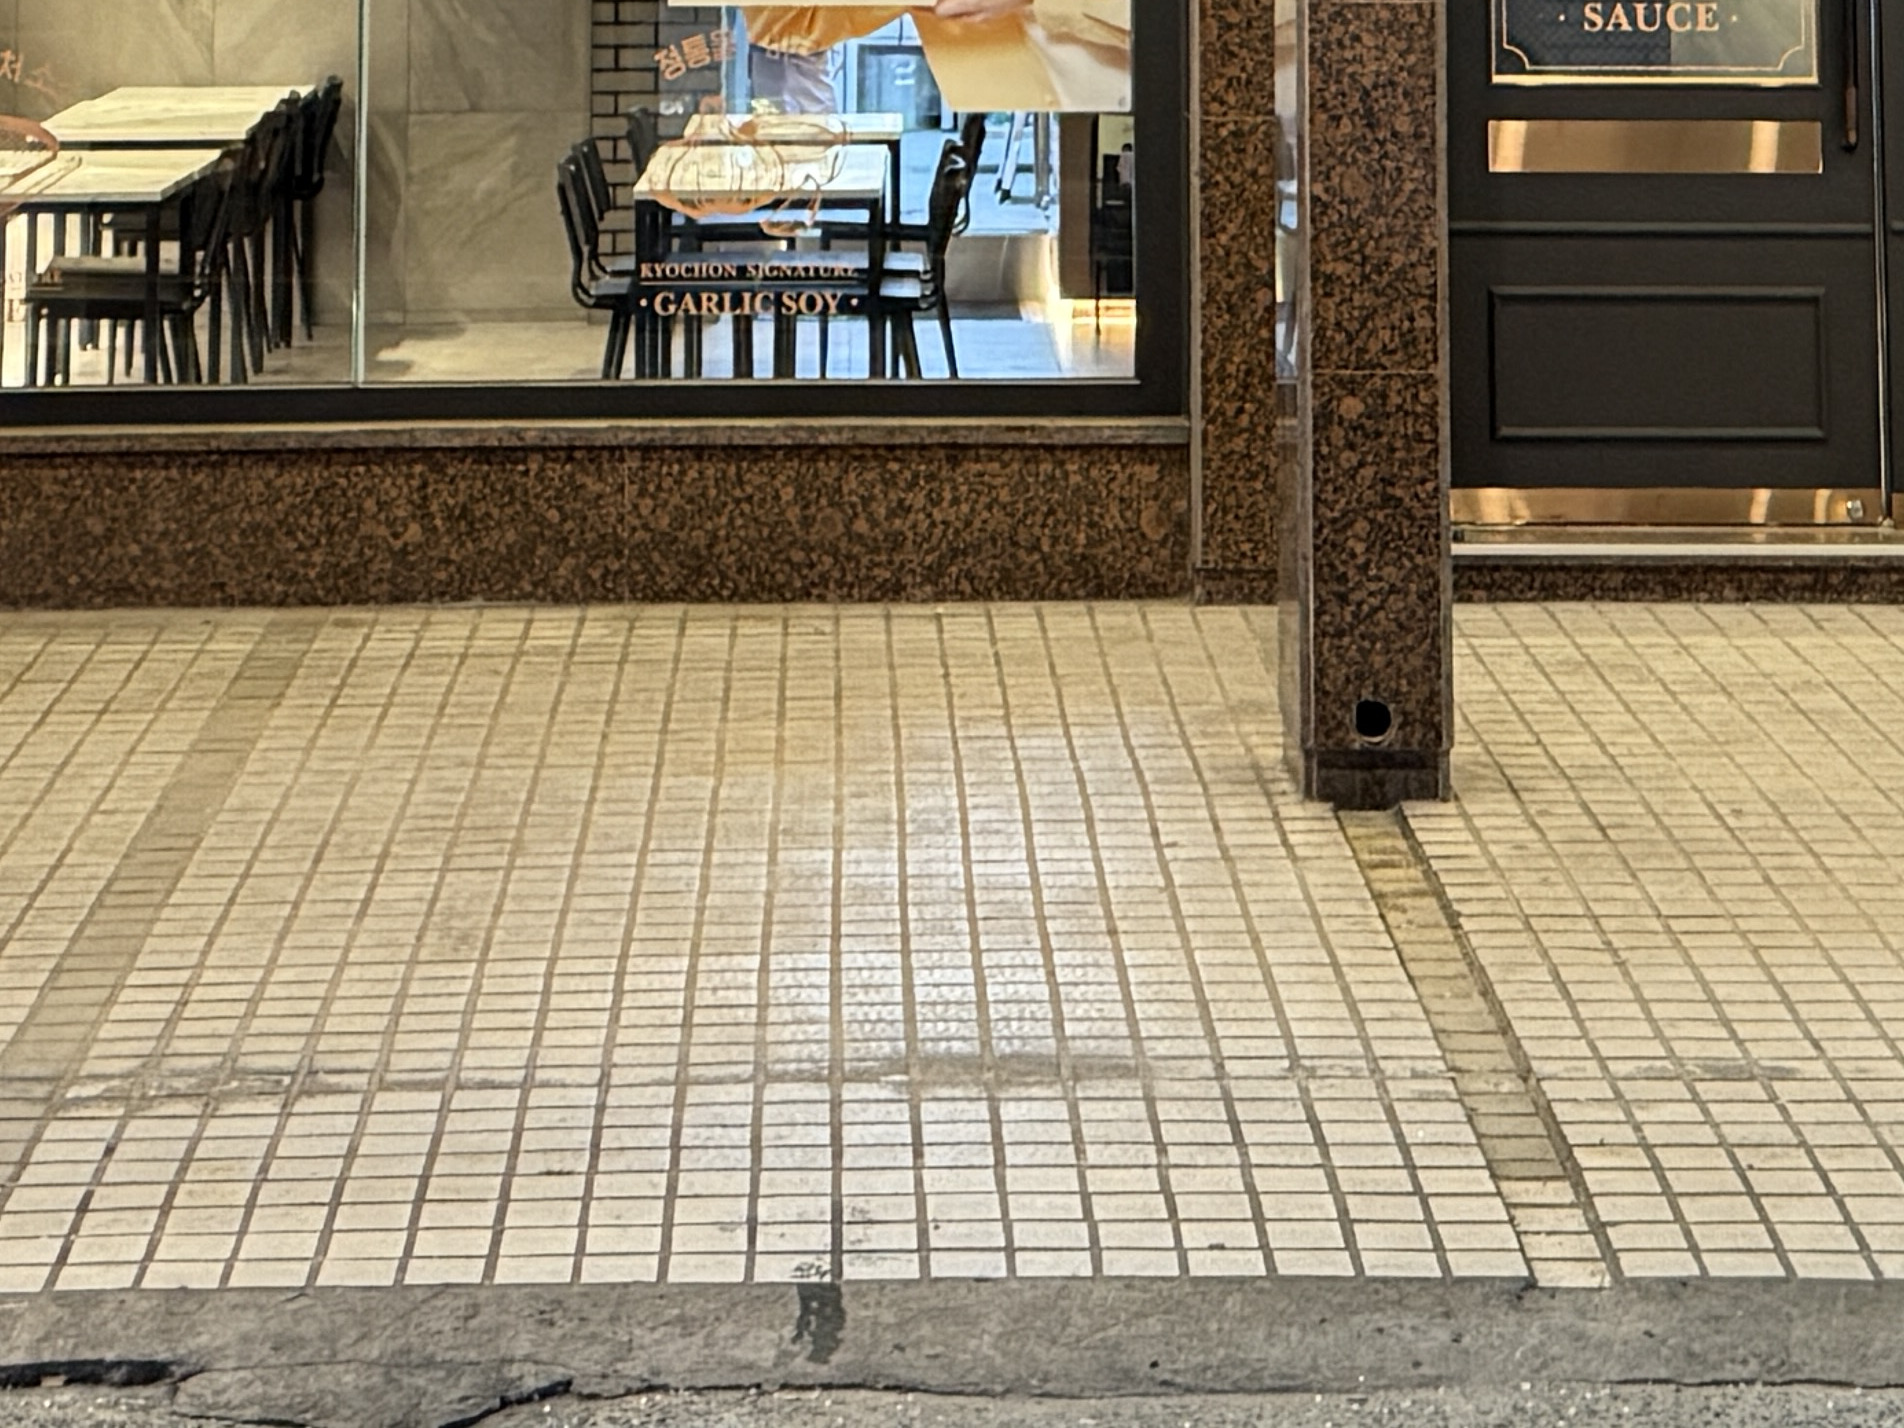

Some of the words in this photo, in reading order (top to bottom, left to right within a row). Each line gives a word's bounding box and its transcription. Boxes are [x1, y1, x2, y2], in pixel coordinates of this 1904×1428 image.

[1582, 1, 1720, 33] SAUCE
[640, 262, 738, 279] KYOCHON
[746, 262, 859, 279] SIGNATURE
[652, 291, 776, 317] GARLIC
[780, 291, 842, 317] SOY
